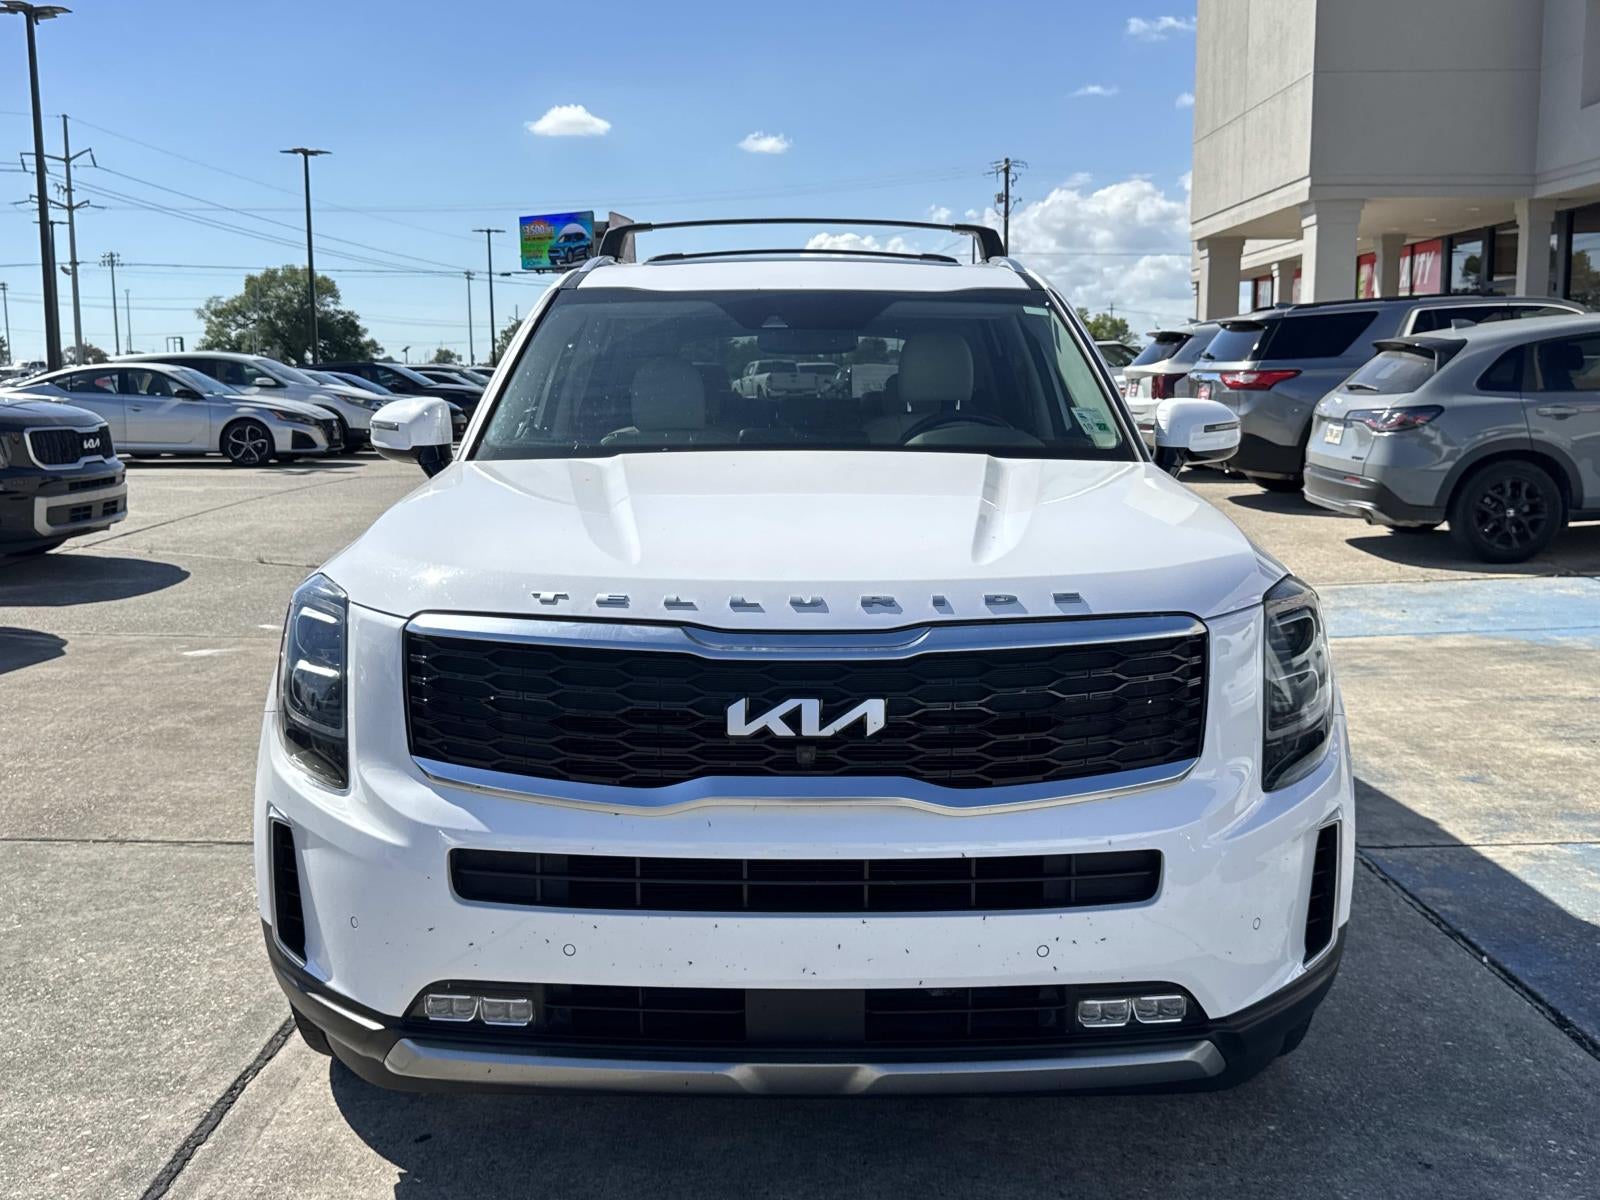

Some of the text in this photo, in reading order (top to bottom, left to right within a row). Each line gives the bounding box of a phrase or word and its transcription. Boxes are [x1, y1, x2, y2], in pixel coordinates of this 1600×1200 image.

[83, 438, 100, 449] KIA
[531, 591, 1087, 613] TELLURIDE
[727, 698, 885, 736] KIA
